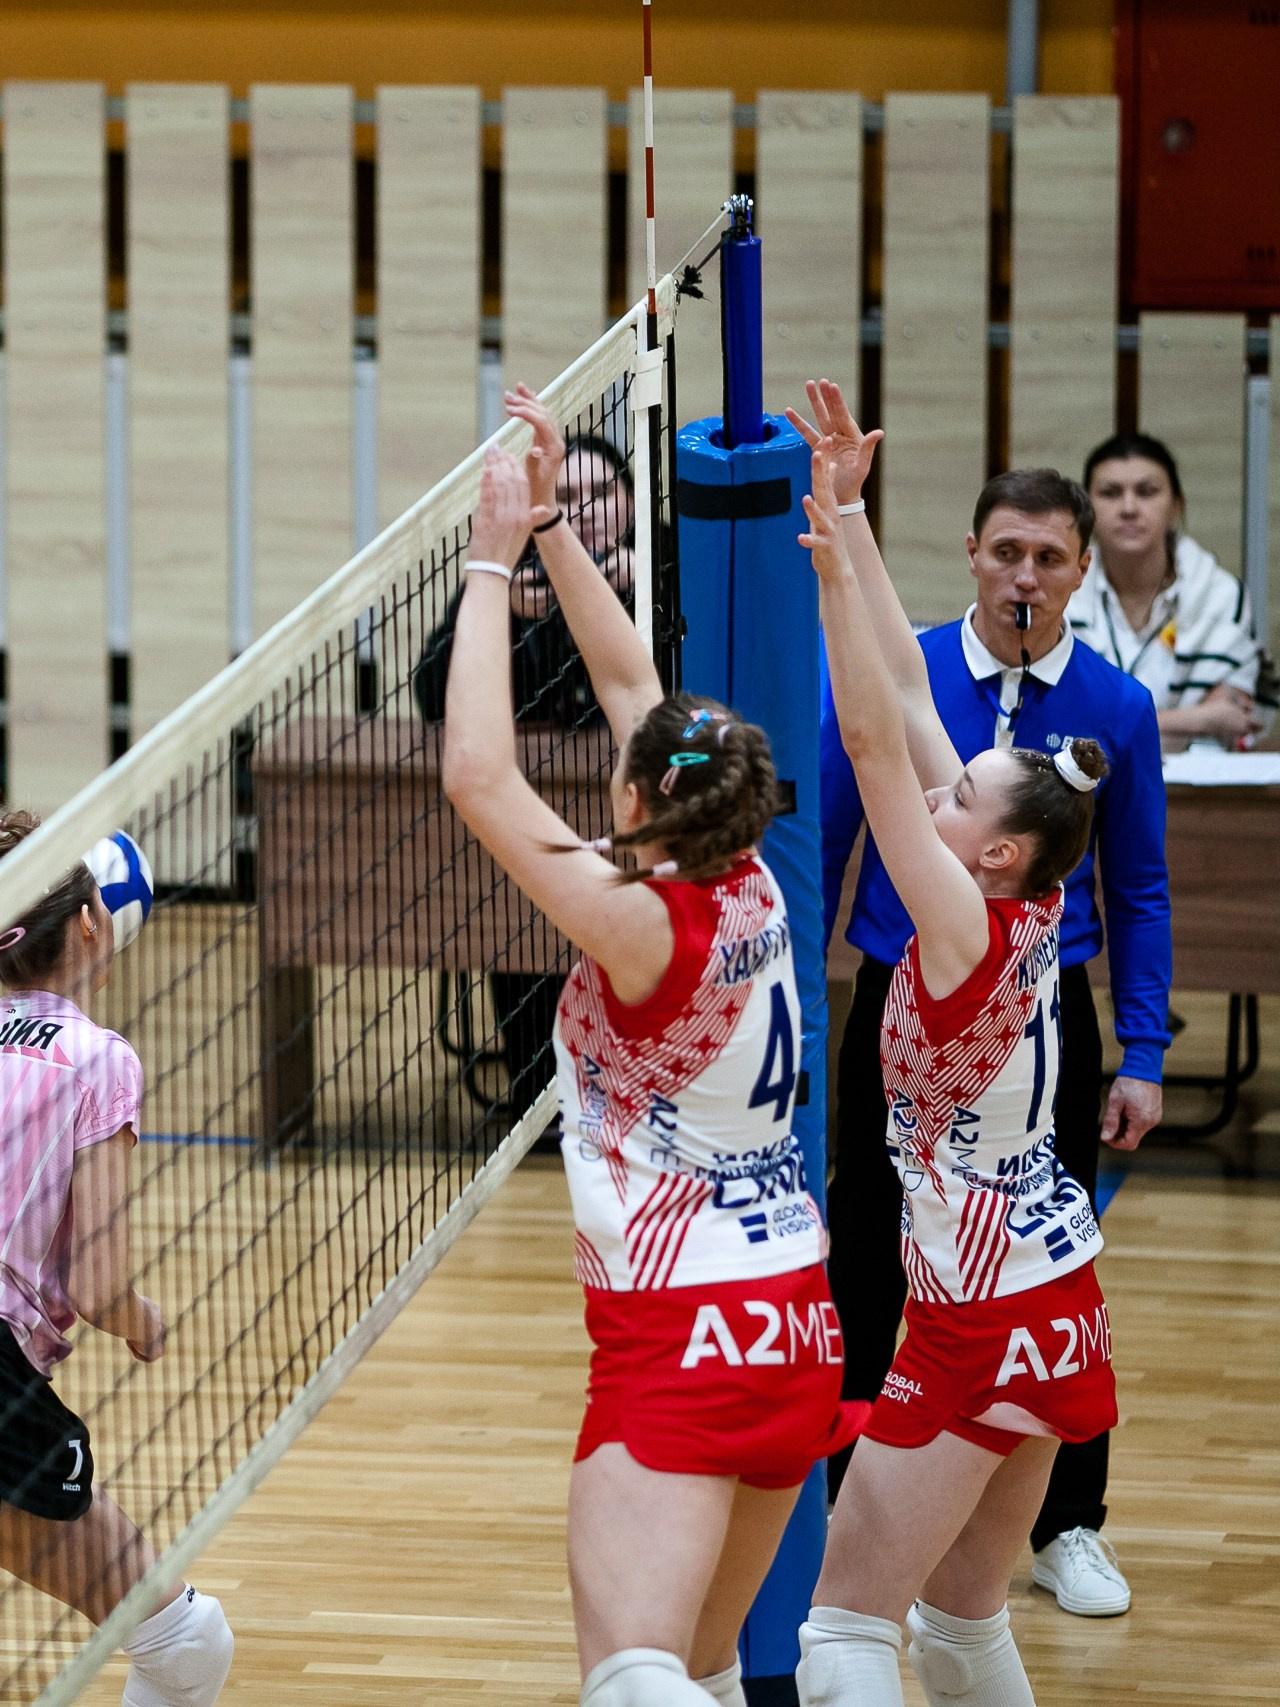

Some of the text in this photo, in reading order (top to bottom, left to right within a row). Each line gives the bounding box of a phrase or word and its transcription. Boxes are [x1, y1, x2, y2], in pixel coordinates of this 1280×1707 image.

[748, 981, 796, 1122] 4
[1024, 979, 1062, 1133] 11
[680, 1300, 844, 1369] A2ME
